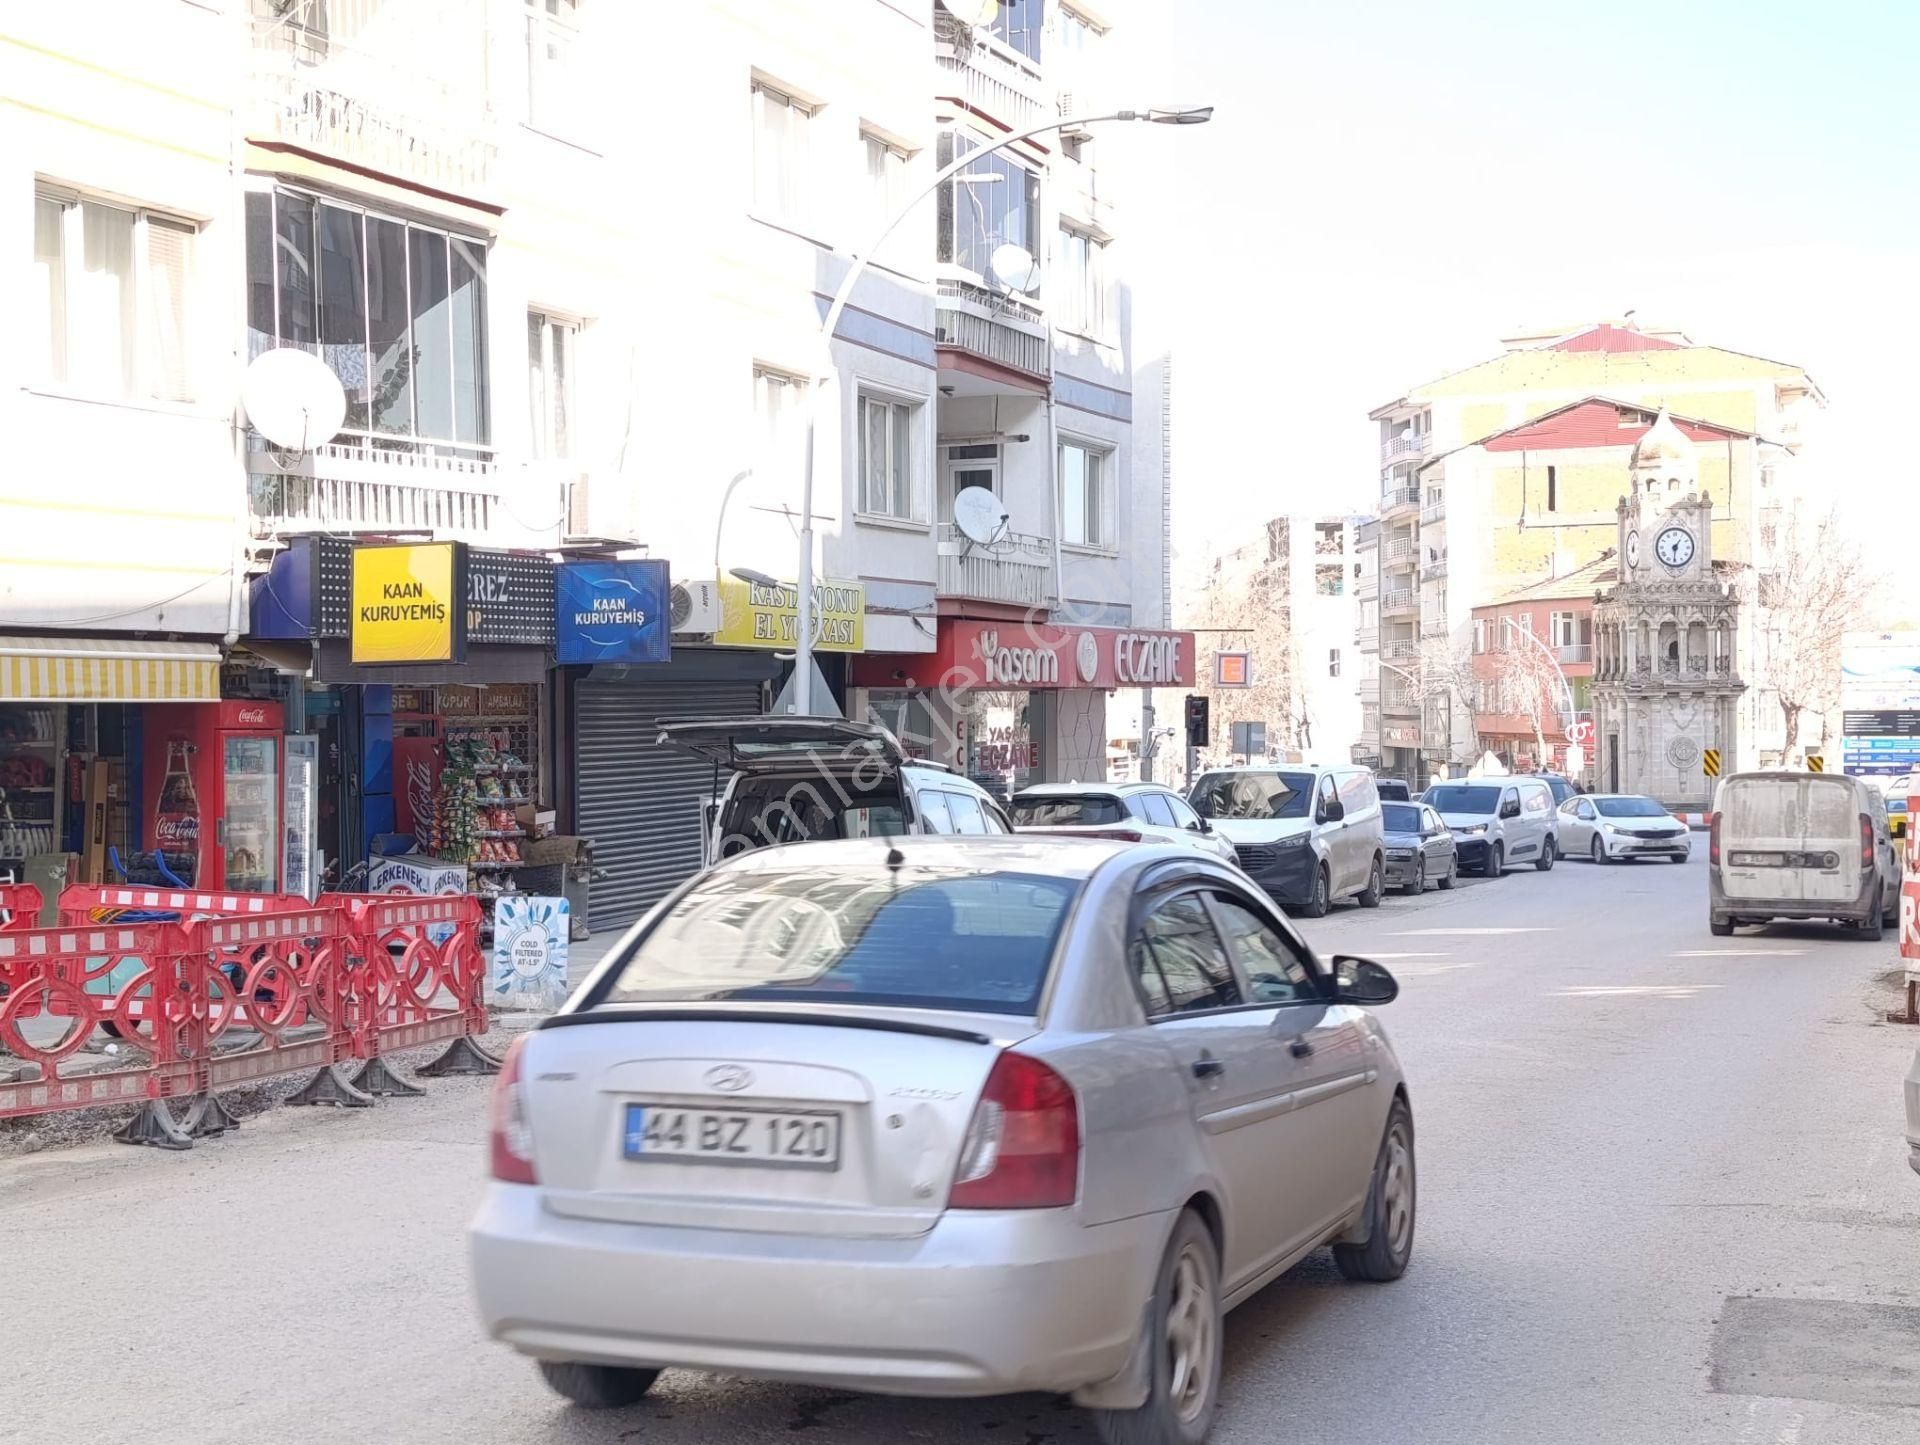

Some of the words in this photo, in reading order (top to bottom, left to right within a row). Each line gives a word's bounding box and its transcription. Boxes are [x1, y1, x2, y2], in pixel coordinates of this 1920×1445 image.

[383, 582, 422, 599] KAAN
[750, 581, 859, 614] KASTMONU
[361, 601, 445, 623] KURUYEMİŞ
[593, 598, 626, 611] KAAN
[575, 608, 645, 626] KURUYEMİŞ
[754, 613, 777, 640] EL
[1114, 633, 1183, 683] ECZANE
[980, 742, 1039, 771] ECZANE
[377, 864, 423, 892] ERKENEK
[514, 949, 543, 957] FILTERED
[520, 940, 539, 948] COLD
[644, 1112, 685, 1149] 44
[701, 1115, 751, 1152] BZ
[767, 1118, 829, 1158] 120
